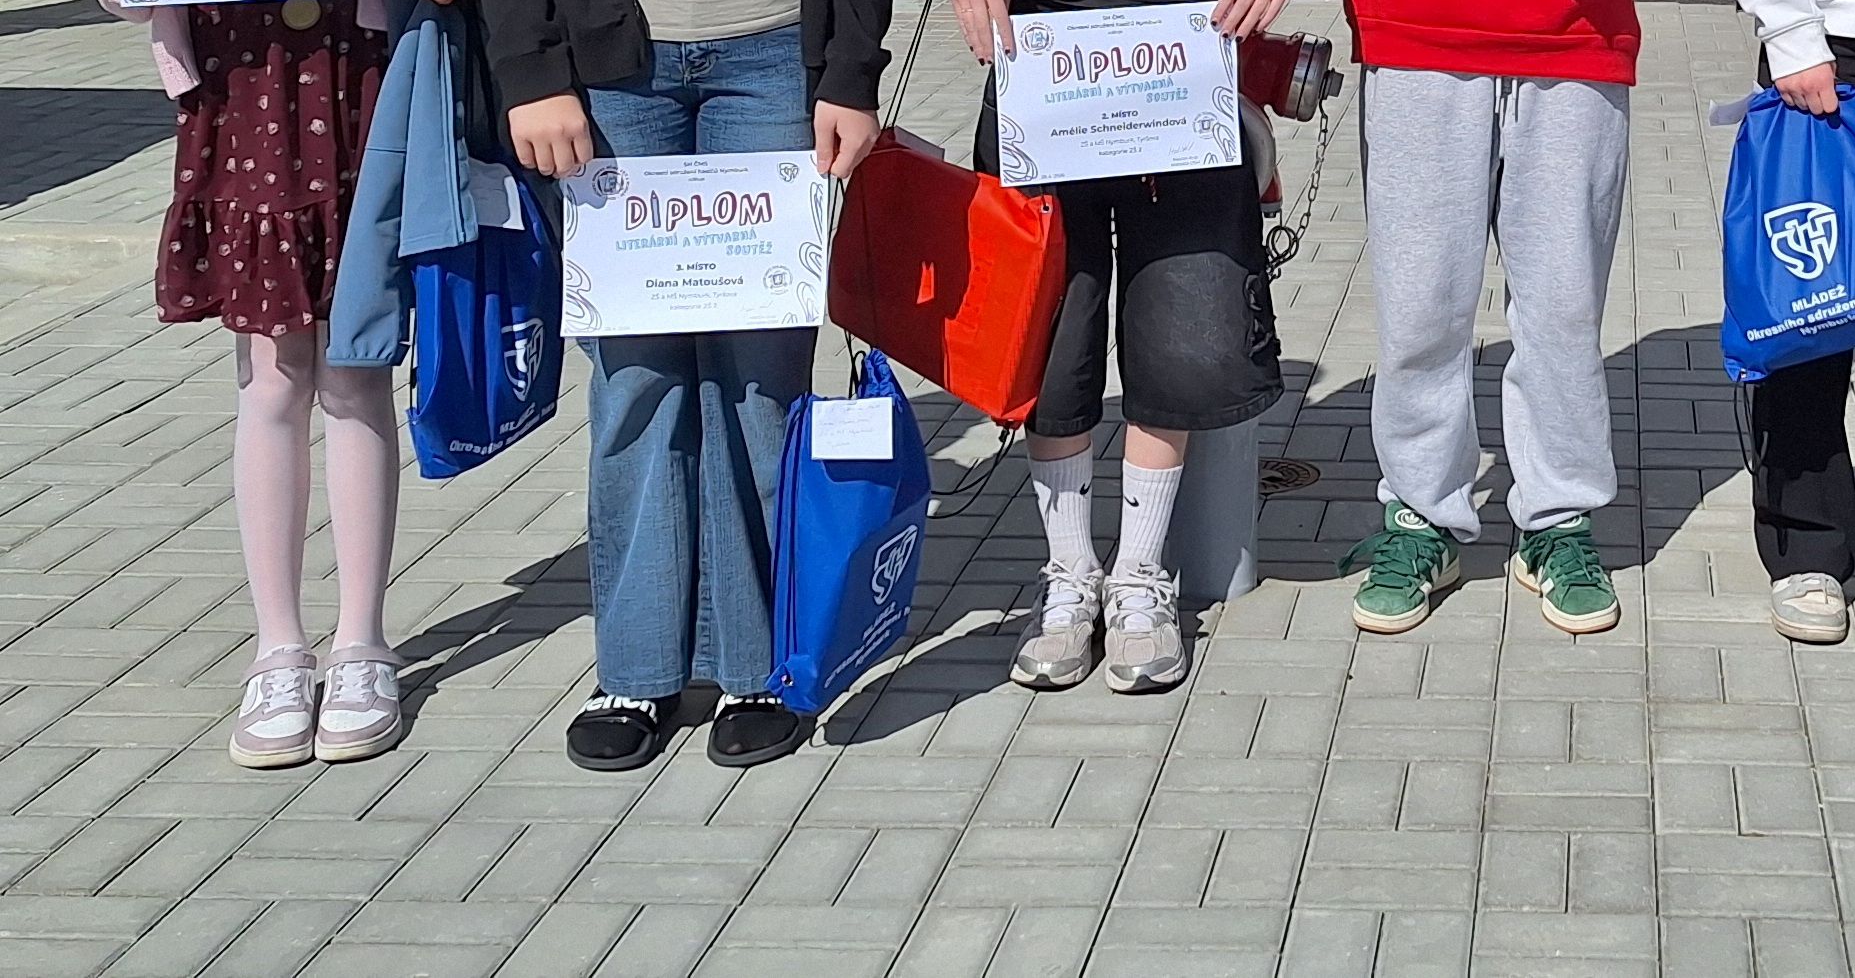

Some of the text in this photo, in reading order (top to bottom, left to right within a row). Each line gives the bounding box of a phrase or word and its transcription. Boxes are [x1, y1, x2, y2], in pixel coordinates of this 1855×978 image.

[1052, 43, 1187, 84] DIPLOM
[1106, 88, 1113, 97] A
[1112, 110, 1138, 118] MÍSTO
[1051, 117, 1187, 137] Amélie Schneiderwindová
[625, 190, 773, 231] DIPLOM
[683, 237, 690, 247] A
[687, 262, 716, 271] MÍSTO
[646, 276, 743, 288] Diana Matoušová
[1792, 283, 1849, 313] MLÁDEŽ
[1746, 318, 1805, 342] Okresního
